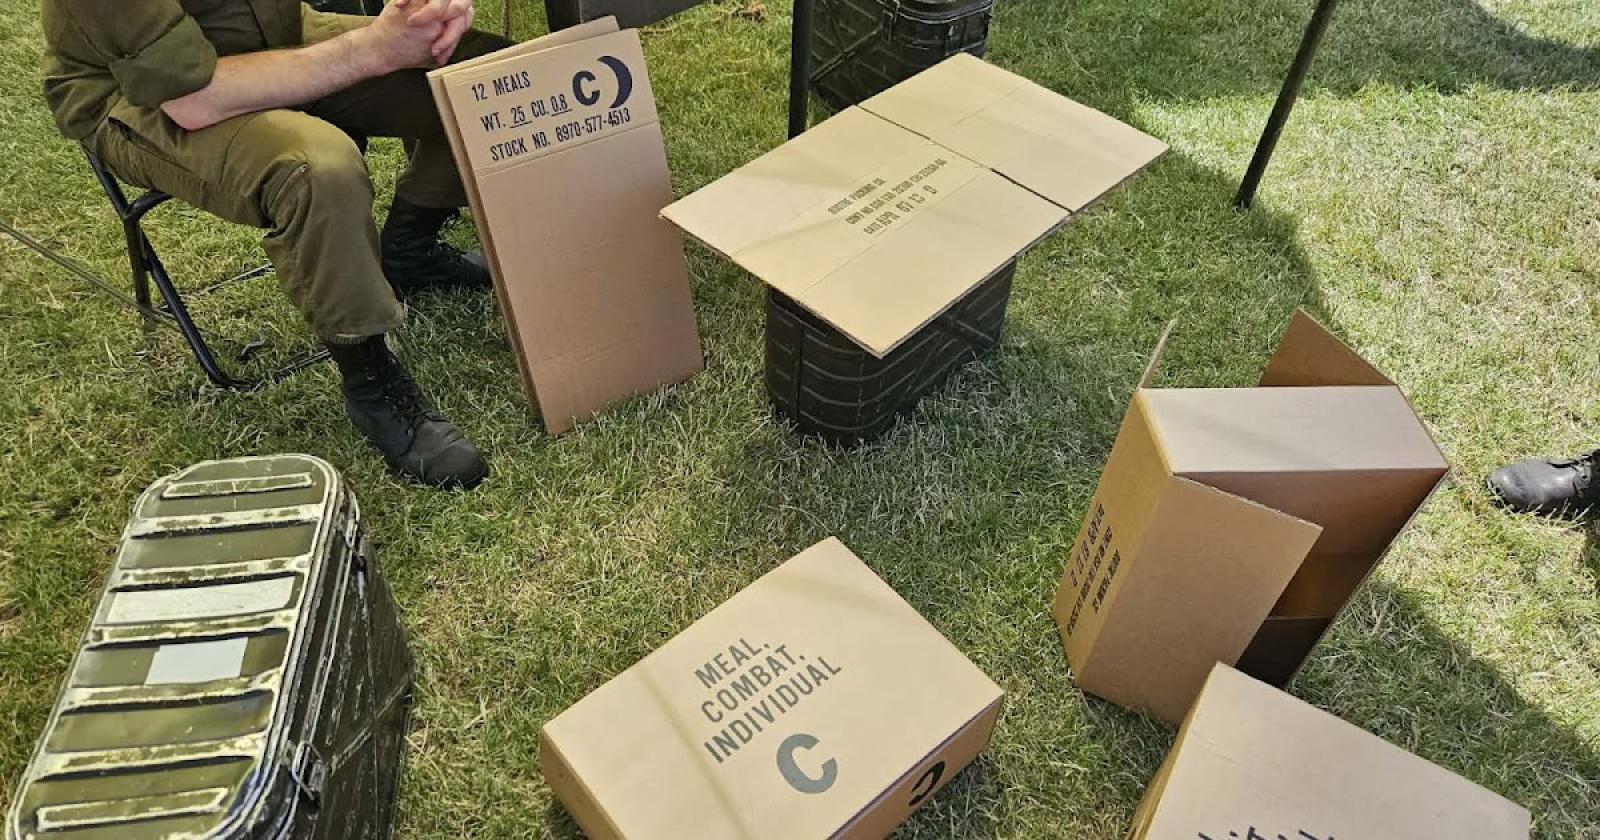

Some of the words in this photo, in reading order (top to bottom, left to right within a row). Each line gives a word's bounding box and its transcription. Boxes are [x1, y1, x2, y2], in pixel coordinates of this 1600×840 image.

[472, 83, 488, 101] 12
[493, 71, 531, 96] MEALS
[572, 70, 600, 106] C
[481, 111, 506, 132] WT.
[510, 106, 527, 125] 25
[531, 99, 549, 118] CU.
[490, 137, 528, 161] STOCK
[532, 131, 551, 149] NO.
[703, 656, 842, 764] INDIVIDUAL
[776, 733, 838, 794] C
